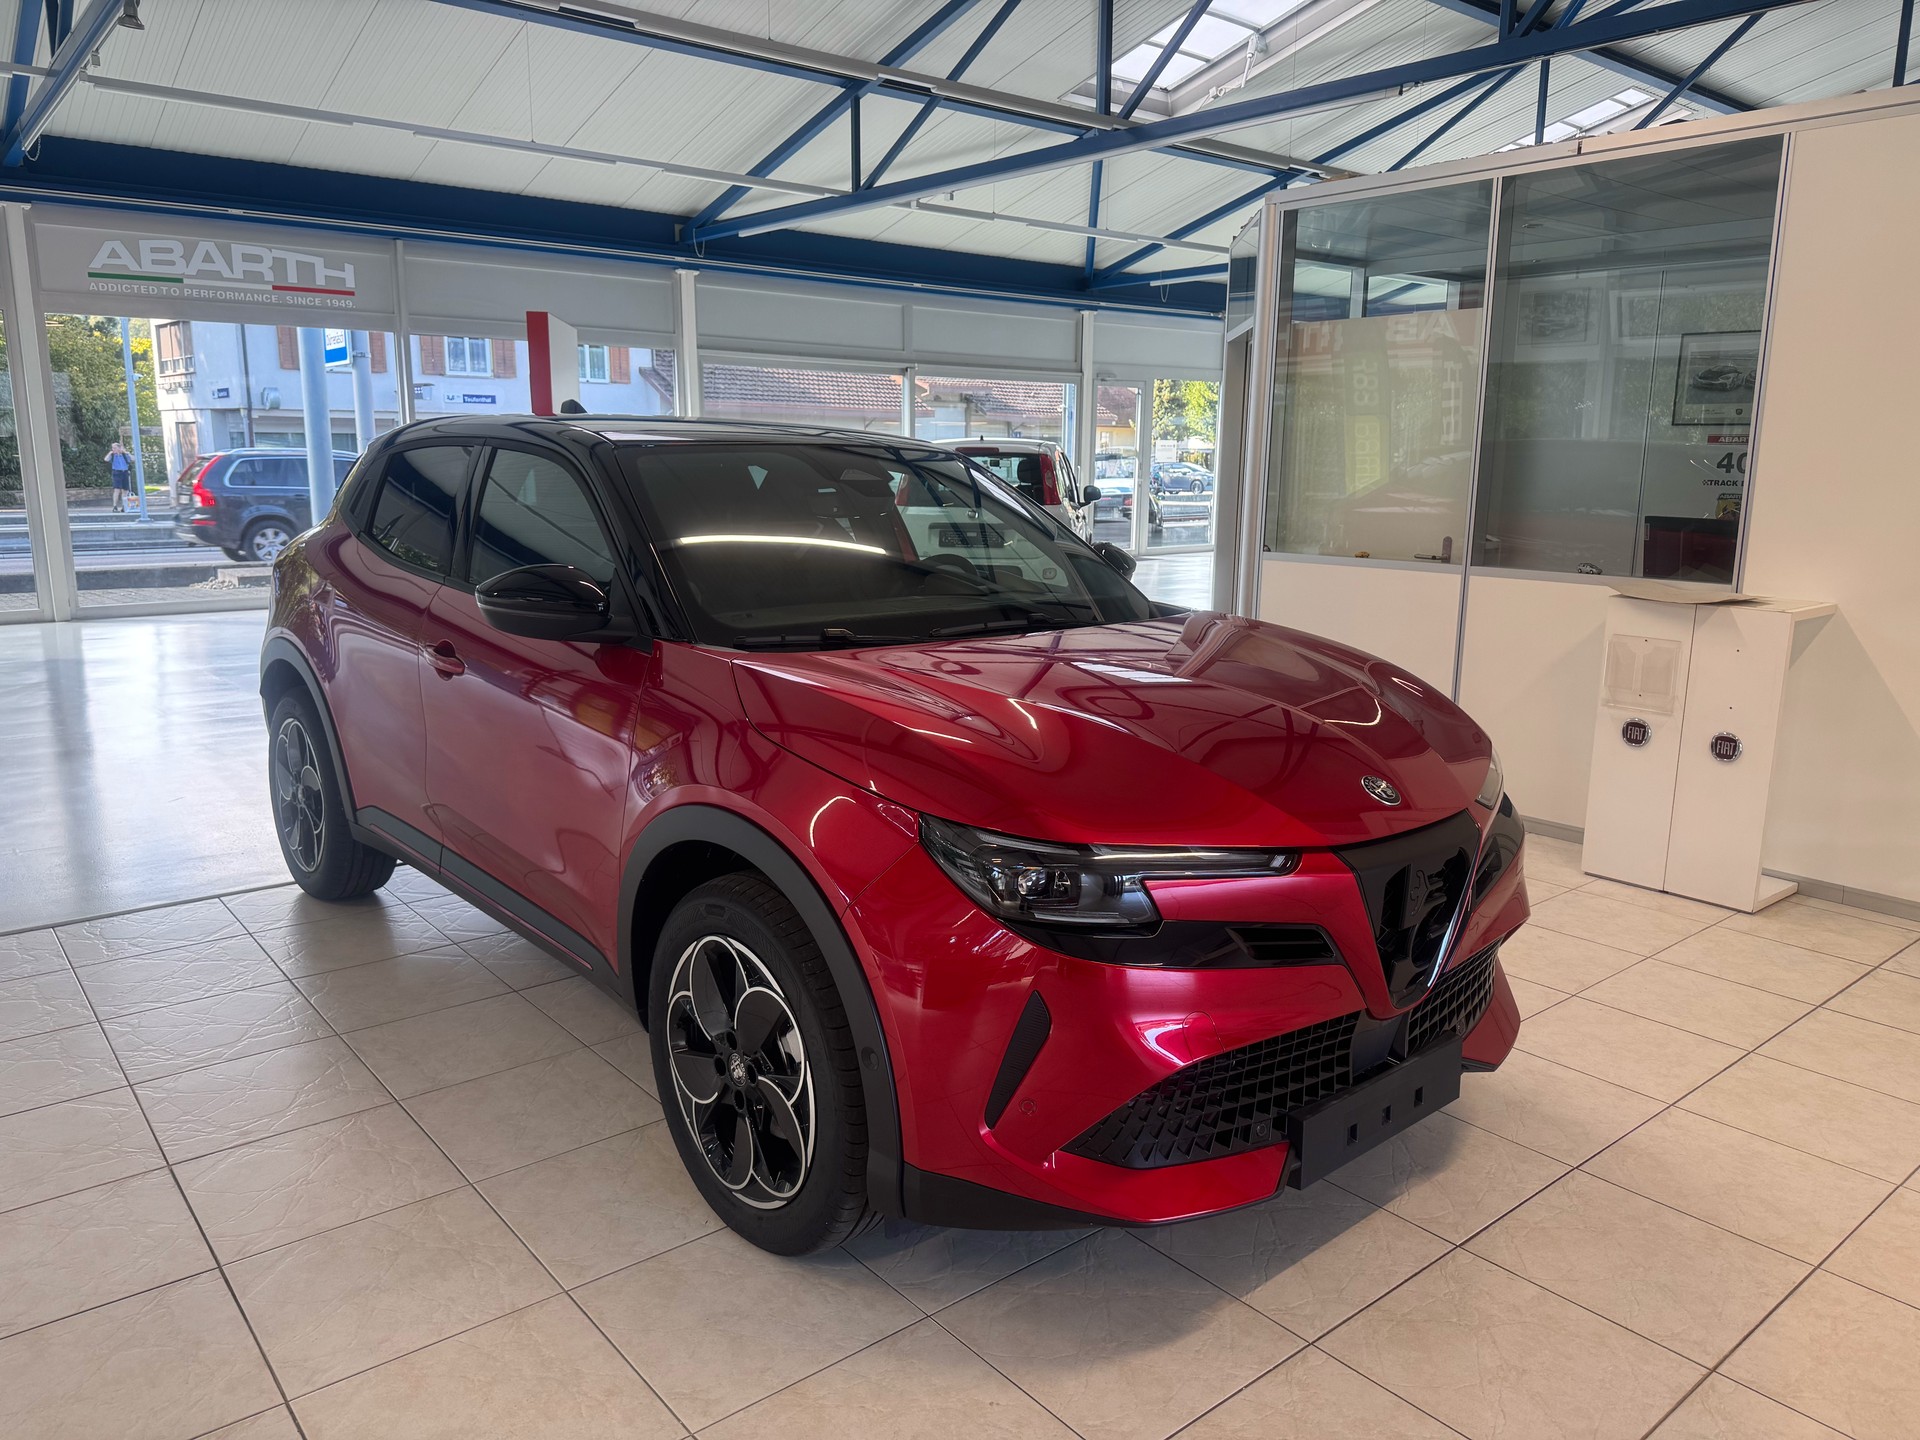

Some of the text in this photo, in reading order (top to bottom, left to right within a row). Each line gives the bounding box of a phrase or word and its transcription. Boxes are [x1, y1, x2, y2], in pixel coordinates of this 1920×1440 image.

[88, 240, 356, 288] ABARTH
[89, 282, 356, 309] ADDICTED TO PERFORMANCE. SINCE 1949.
[1628, 725, 1645, 740] FIAT
[1717, 740, 1736, 756] FIAT
